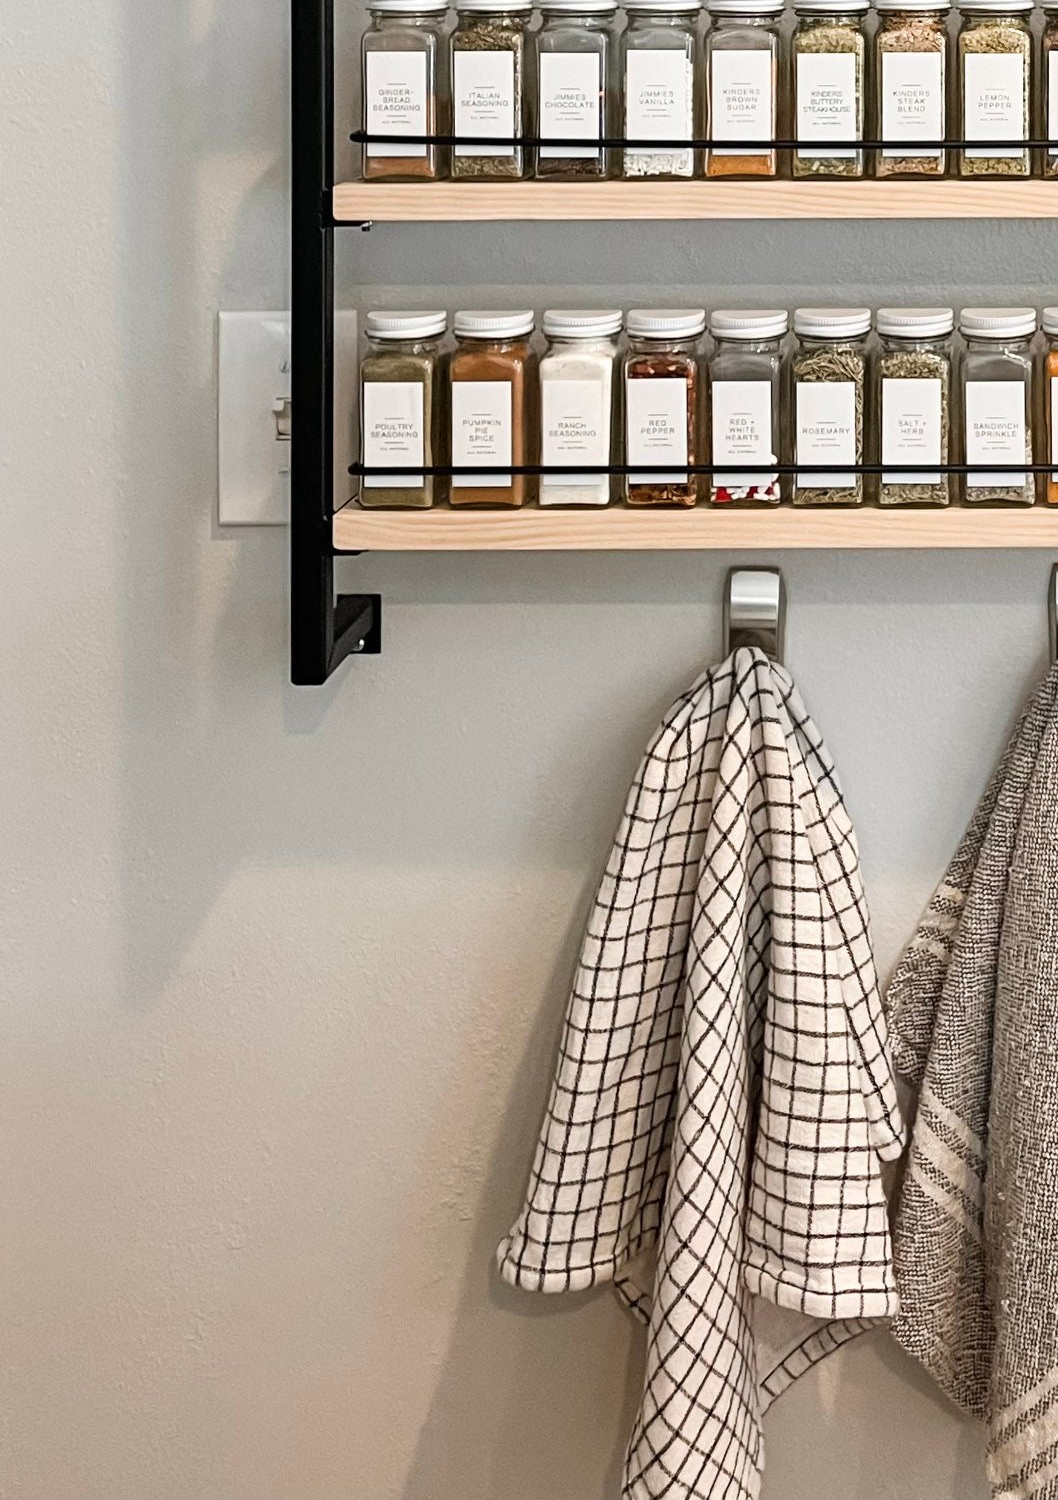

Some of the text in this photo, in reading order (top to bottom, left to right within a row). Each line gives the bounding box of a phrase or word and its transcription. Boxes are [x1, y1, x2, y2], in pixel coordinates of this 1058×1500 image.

[468, 91, 500, 100] ITALIAN
[722, 88, 761, 96] KINDERS
[811, 90, 843, 98] KINDERS
[892, 90, 930, 98] KINDERS
[382, 96, 410, 104] BREAD
[639, 98, 675, 106] VANILLA
[726, 96, 758, 104] BROWN
[810, 98, 843, 106] BUTTERY
[898, 97, 925, 105] STEAK
[979, 94, 1010, 102] LEMON
[460, 99, 509, 108] SEASONING
[545, 100, 595, 109] CHOCOLATE
[727, 103, 757, 111] SUGAR
[978, 101, 1012, 110] PEPPER
[373, 104, 421, 112] SEASONING
[897, 105, 926, 113] BLEND
[462, 419, 502, 427] PUMPKIN
[558, 421, 586, 430] RANCH
[649, 419, 667, 427] RED
[729, 418, 747, 426] RED
[897, 420, 920, 428] SALT
[973, 422, 1019, 430] SANDWICH
[375, 423, 414, 431] POULTRY
[474, 426, 489, 435] PIE
[640, 427, 675, 435] PEPPER
[729, 425, 755, 434] WHITE
[802, 427, 850, 435] ROSEMARY
[901, 427, 924, 435] HERB
[370, 430, 418, 439] SEASONING
[548, 429, 597, 438] SEASONING
[725, 433, 760, 442] HEARTS
[469, 434, 494, 443] SPICE
